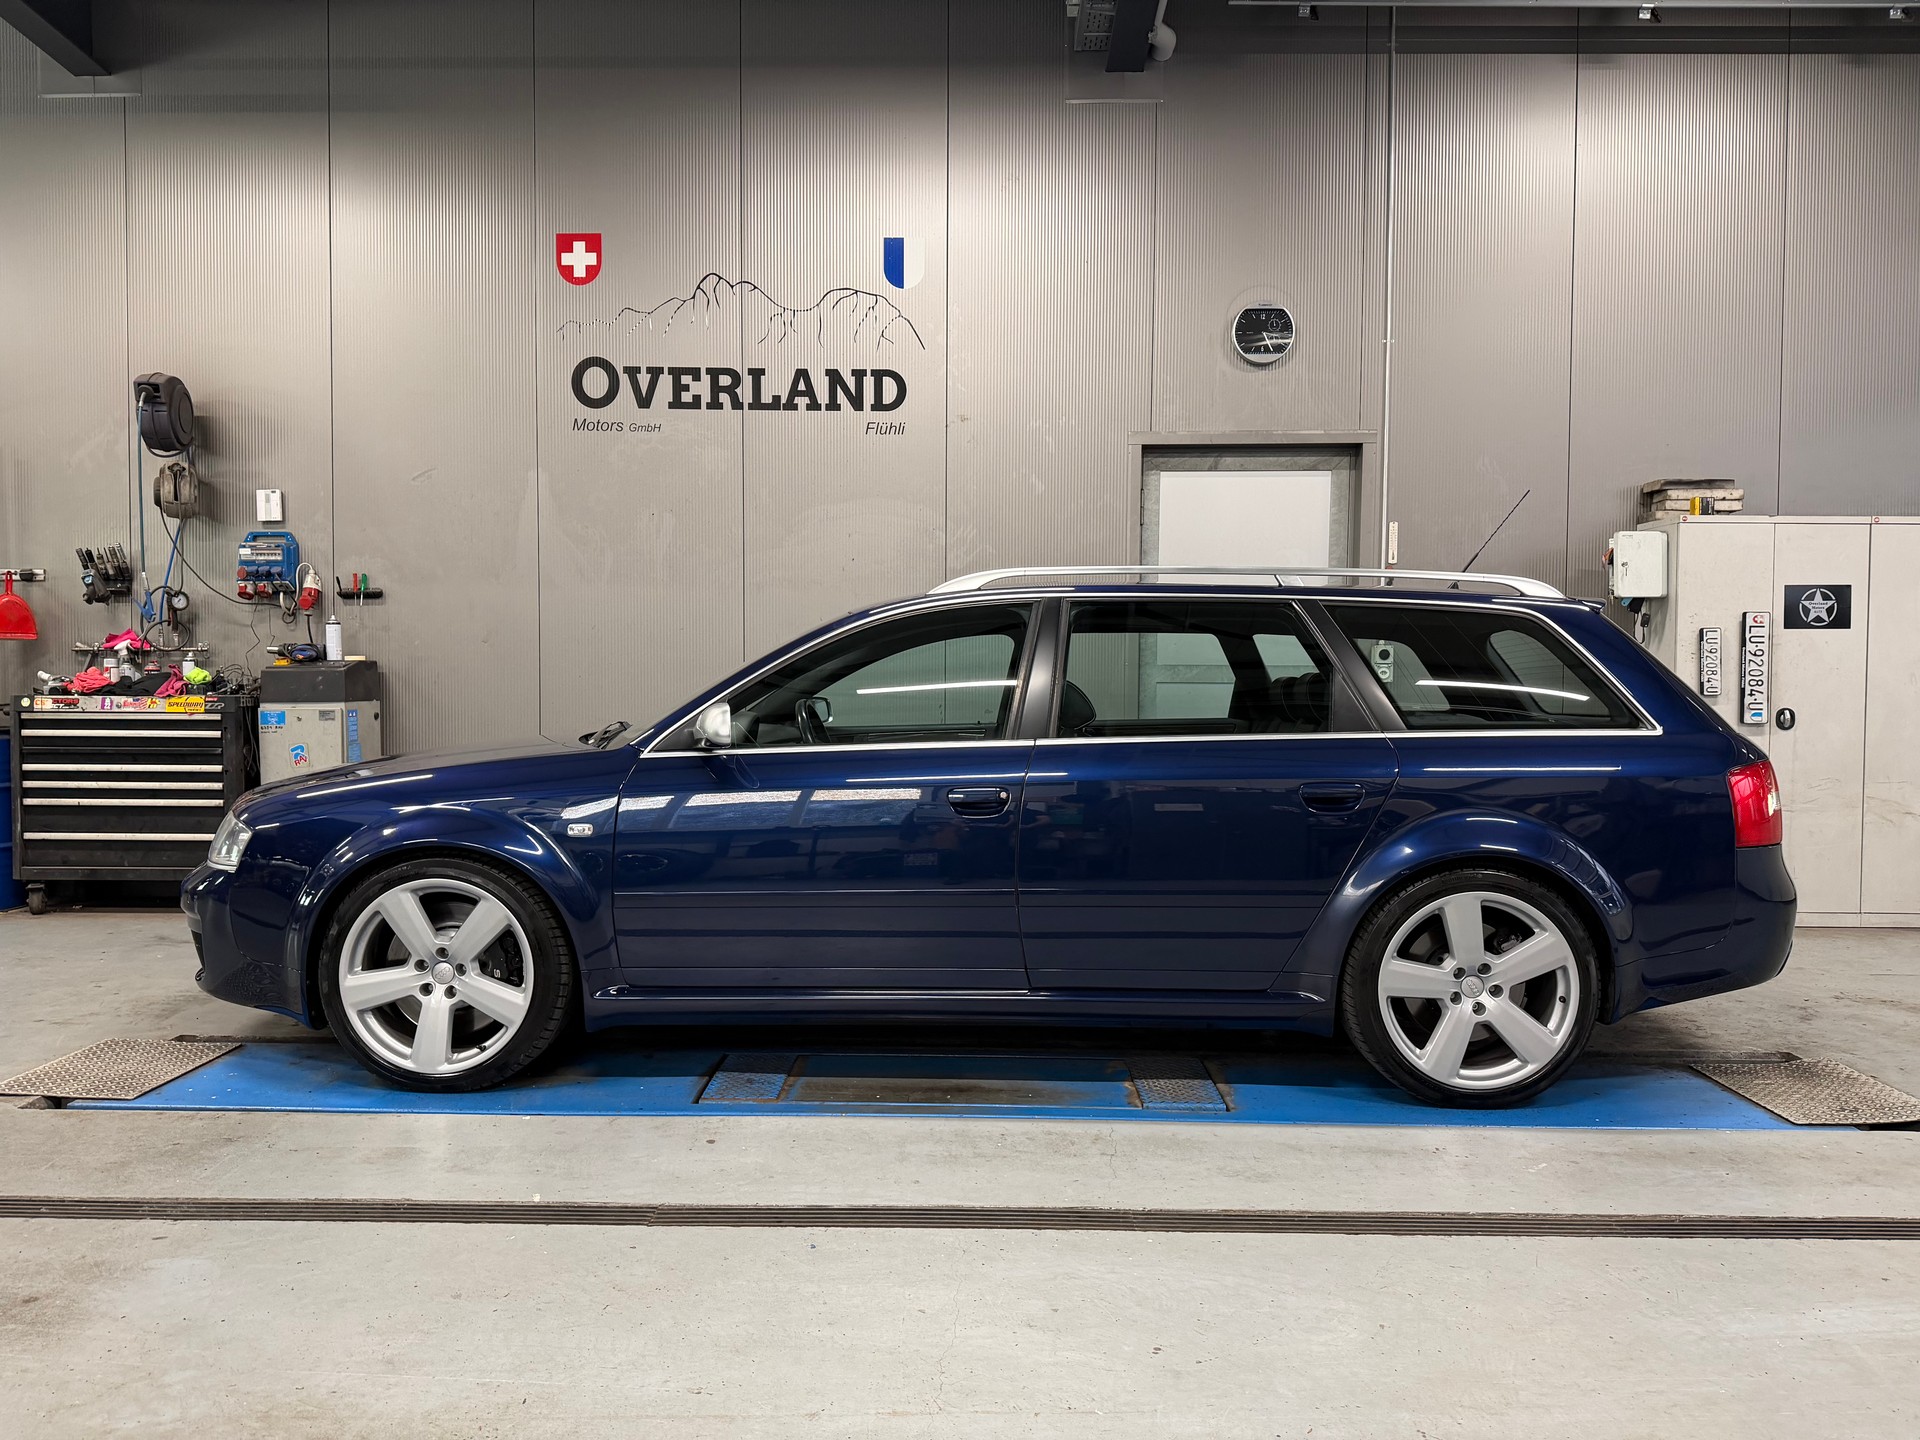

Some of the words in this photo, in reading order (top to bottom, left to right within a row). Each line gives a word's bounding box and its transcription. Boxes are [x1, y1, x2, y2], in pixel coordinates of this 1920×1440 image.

[571, 355, 907, 412] OVERLAND
[572, 417, 624, 433] Motors
[628, 422, 662, 433] GmbH
[865, 420, 906, 436] Flühli
